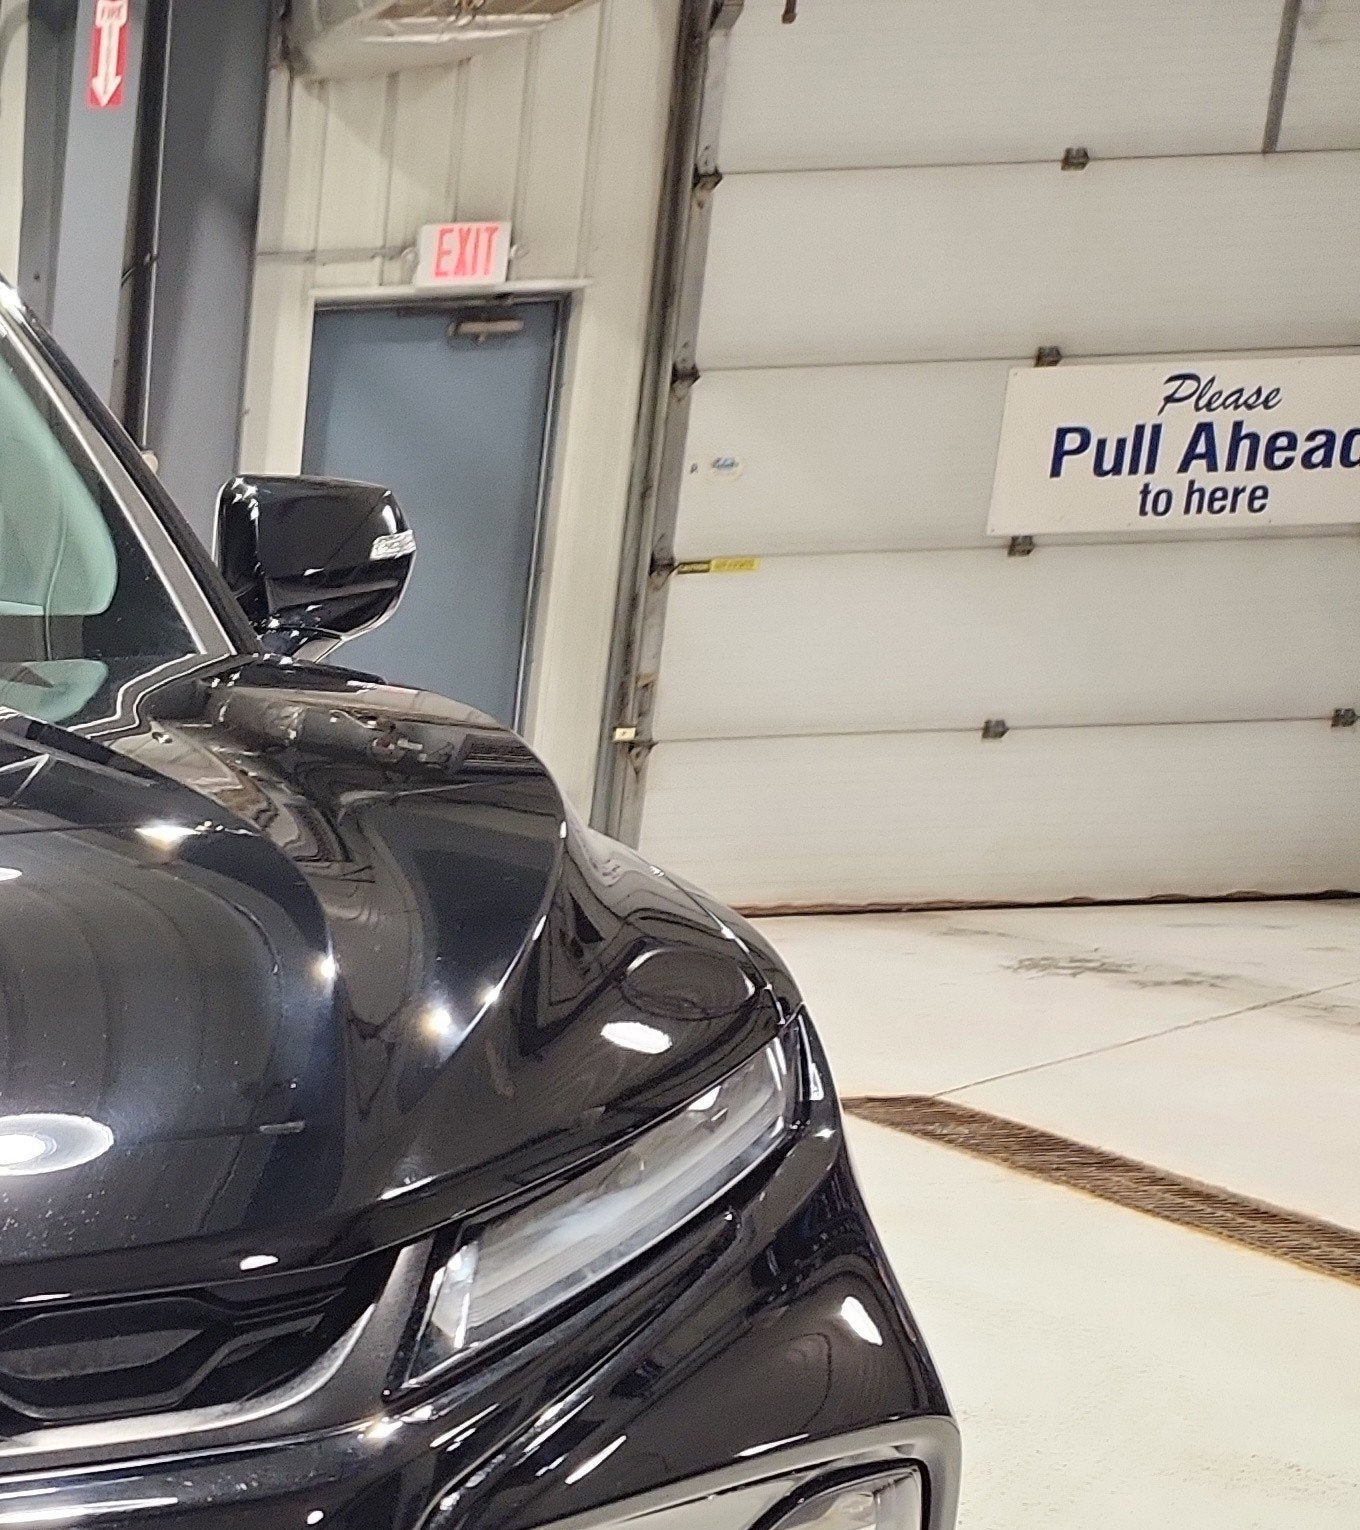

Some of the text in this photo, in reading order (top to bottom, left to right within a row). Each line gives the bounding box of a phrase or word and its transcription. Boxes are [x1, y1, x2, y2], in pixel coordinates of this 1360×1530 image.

[434, 226, 499, 278] EXIT
[1157, 372, 1282, 416] Please
[1049, 422, 1163, 479] Pull
[1138, 479, 1270, 517] to here
